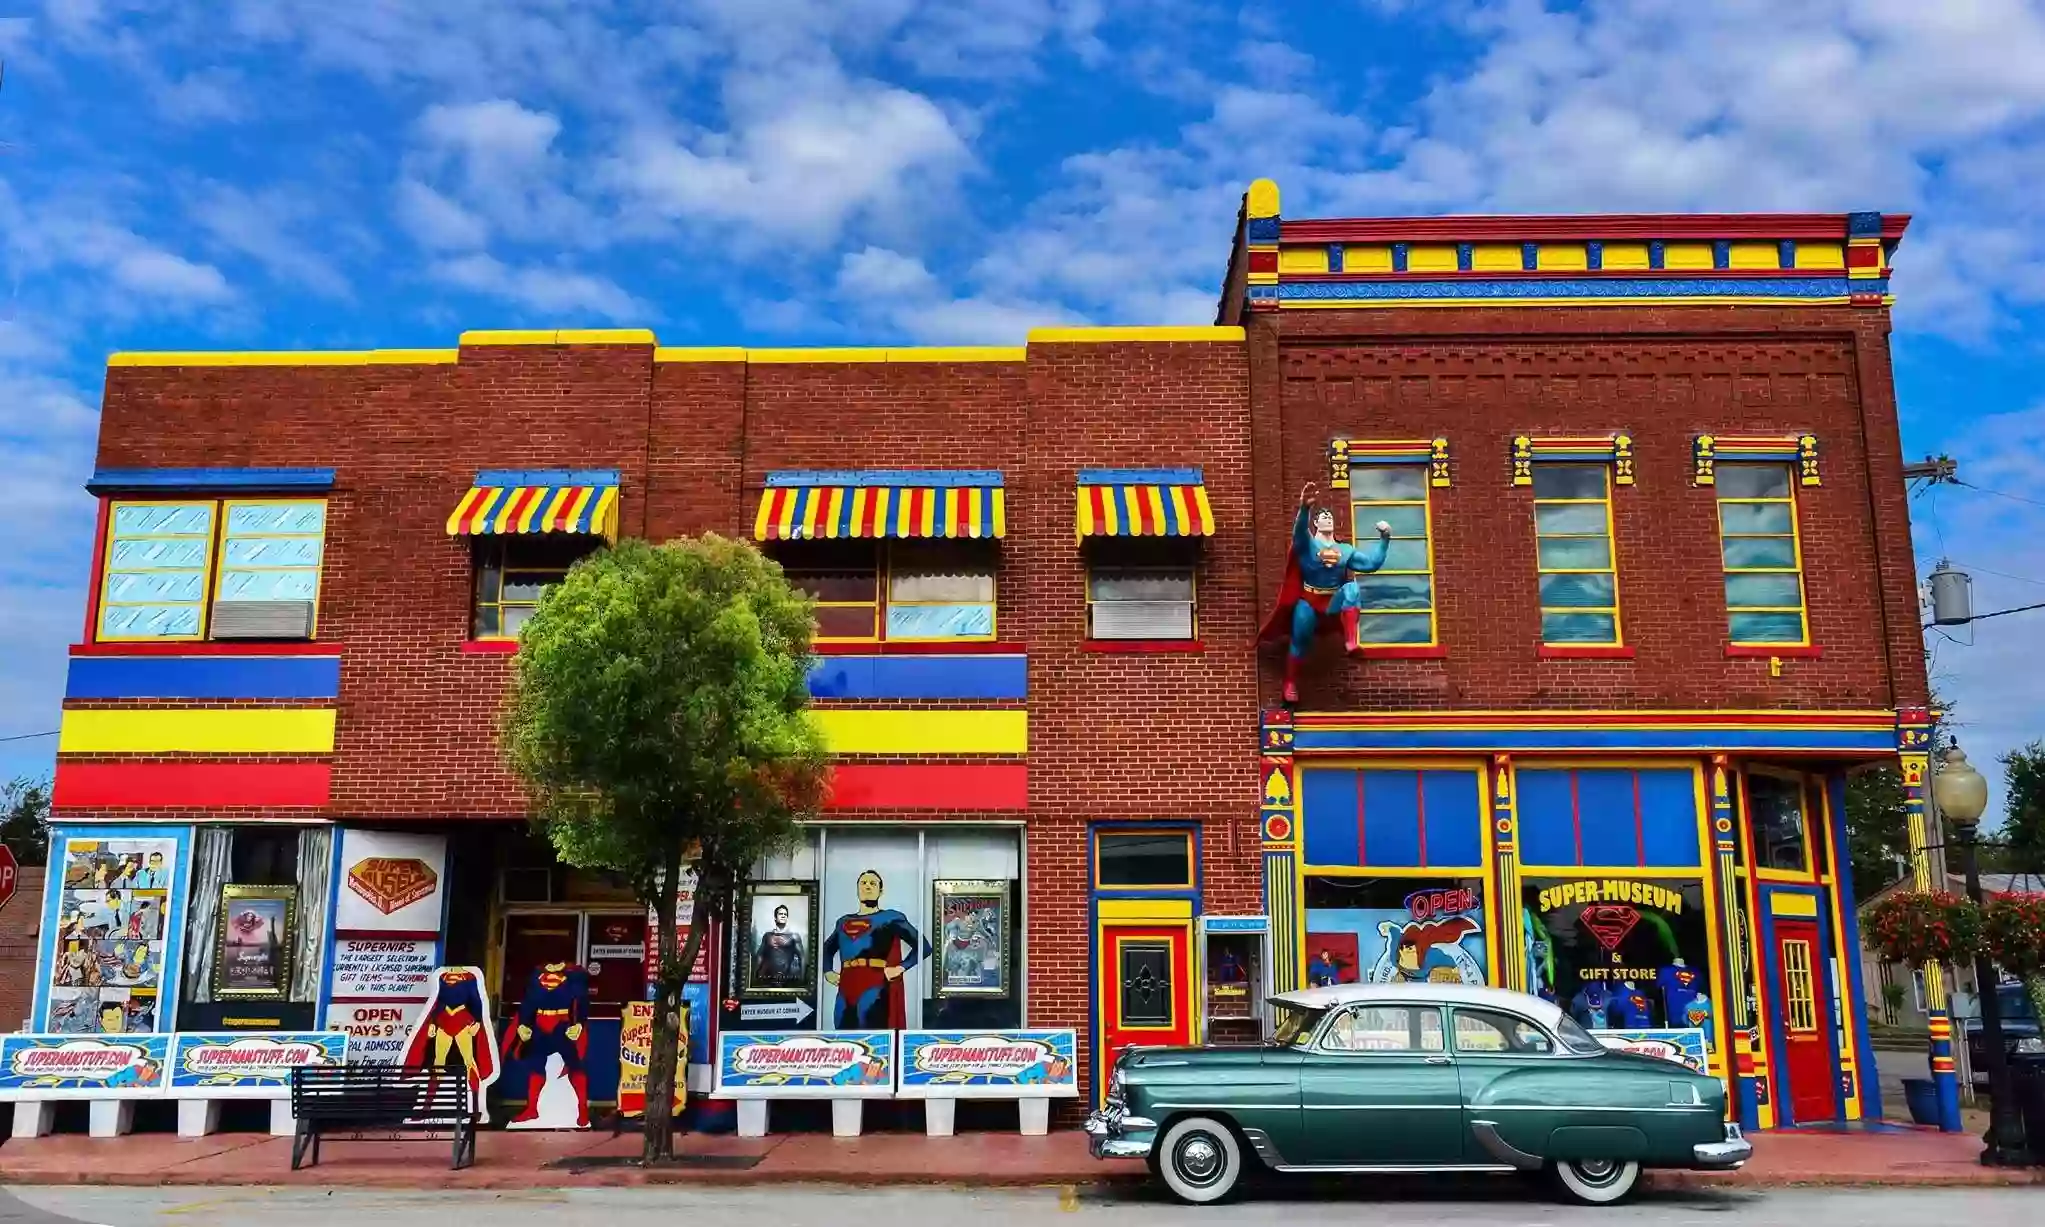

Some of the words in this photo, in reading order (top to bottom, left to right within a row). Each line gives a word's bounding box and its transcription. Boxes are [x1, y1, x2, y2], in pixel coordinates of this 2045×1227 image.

[1412, 888, 1473, 919] OPEN
[1539, 881, 1599, 912] SUPER
[1603, 880, 1682, 915] MUSEUM
[387, 954, 418, 962] SELECTION
[1611, 952, 1622, 963] &
[332, 963, 368, 972] CURRENTLY
[371, 963, 402, 972] LICENSED
[340, 973, 357, 982] GIFT
[360, 973, 383, 982] ITEMS
[1580, 968, 1610, 980] GIFT
[1612, 968, 1657, 980] STORE
[355, 984, 365, 992] ON
[371, 984, 386, 992] THIS
[388, 984, 414, 992] PLANET
[354, 1009, 403, 1021] OPEN
[344, 1025, 380, 1037] DAYS
[364, 1041, 405, 1052] ADMISSIO
[24, 1050, 132, 1066] SUPERMANSTUFF.COM
[196, 1049, 310, 1065] SUPERMANSTUFF.COM
[622, 1047, 646, 1066] Gift
[746, 1048, 855, 1064] SUPERMANSTUFF.COM
[928, 1047, 1038, 1063] SUPERMANSTUFF.COM
